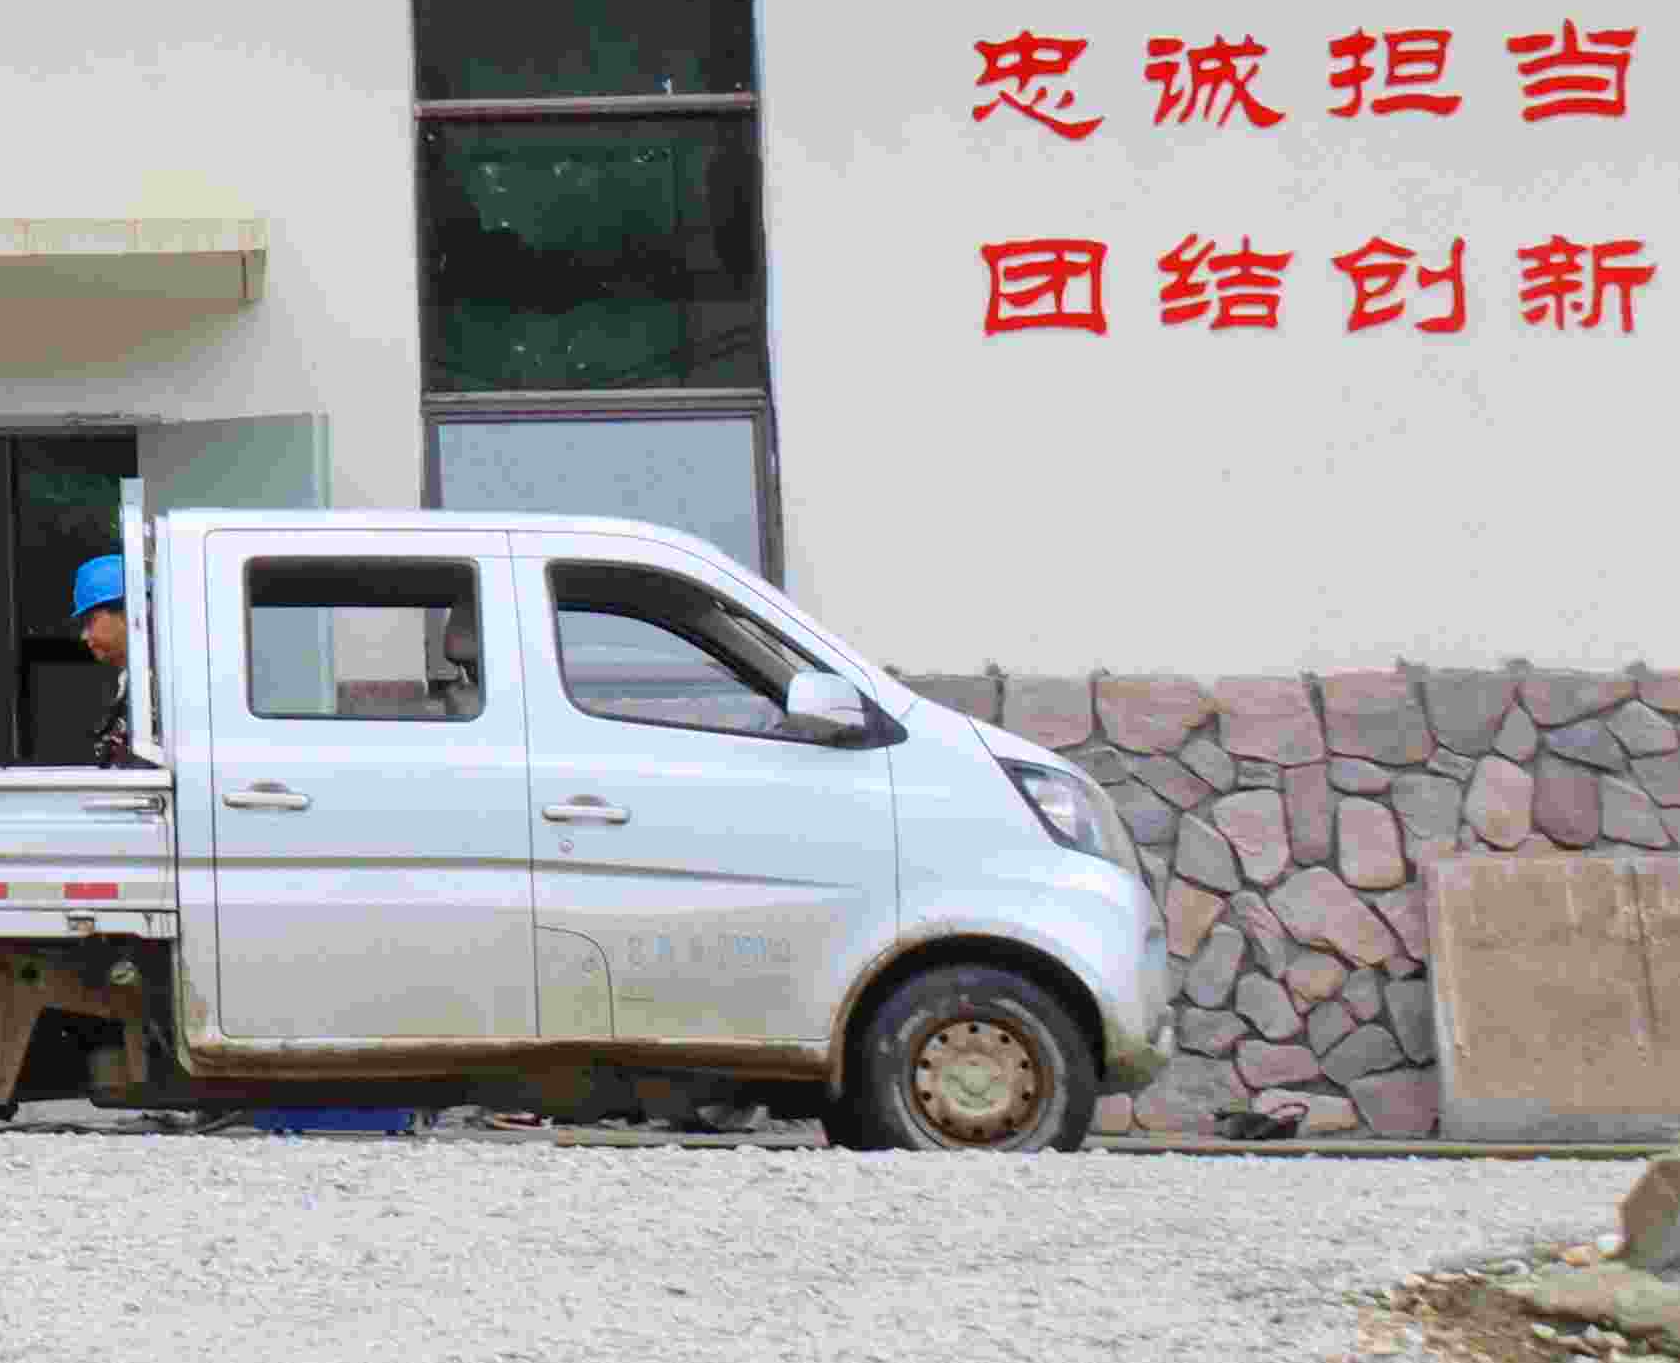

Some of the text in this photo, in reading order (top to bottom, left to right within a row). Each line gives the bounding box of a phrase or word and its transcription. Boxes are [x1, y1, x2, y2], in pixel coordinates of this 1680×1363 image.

[972, 19, 1638, 140] 忠诚担当
[980, 234, 1656, 336] 团结创新
